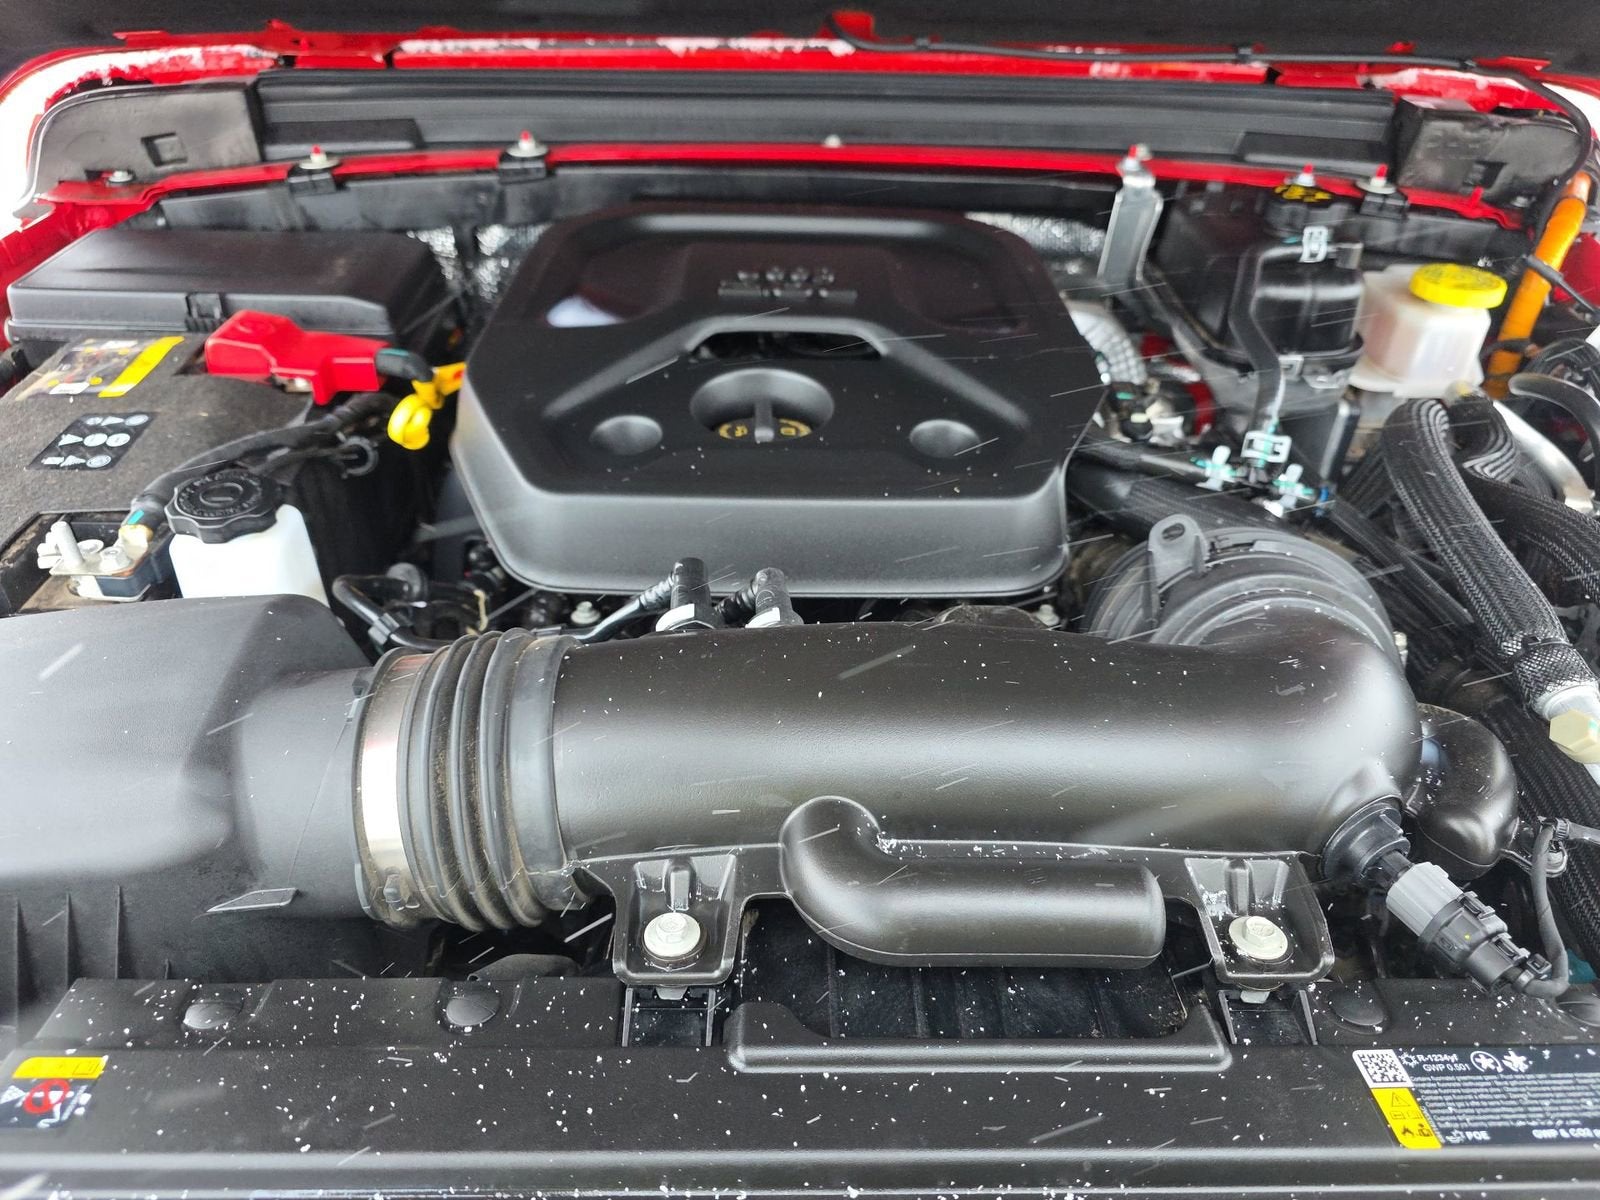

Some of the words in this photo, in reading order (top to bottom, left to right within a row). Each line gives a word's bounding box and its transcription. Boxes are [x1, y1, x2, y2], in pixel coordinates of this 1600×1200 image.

[1416, 1053, 1458, 1063] R-1234yf
[1423, 1063, 1445, 1072] GWP
[1446, 1063, 1471, 1072] 0.501
[1466, 1130, 1491, 1141] POE
[1532, 1128, 1559, 1139] GWP
